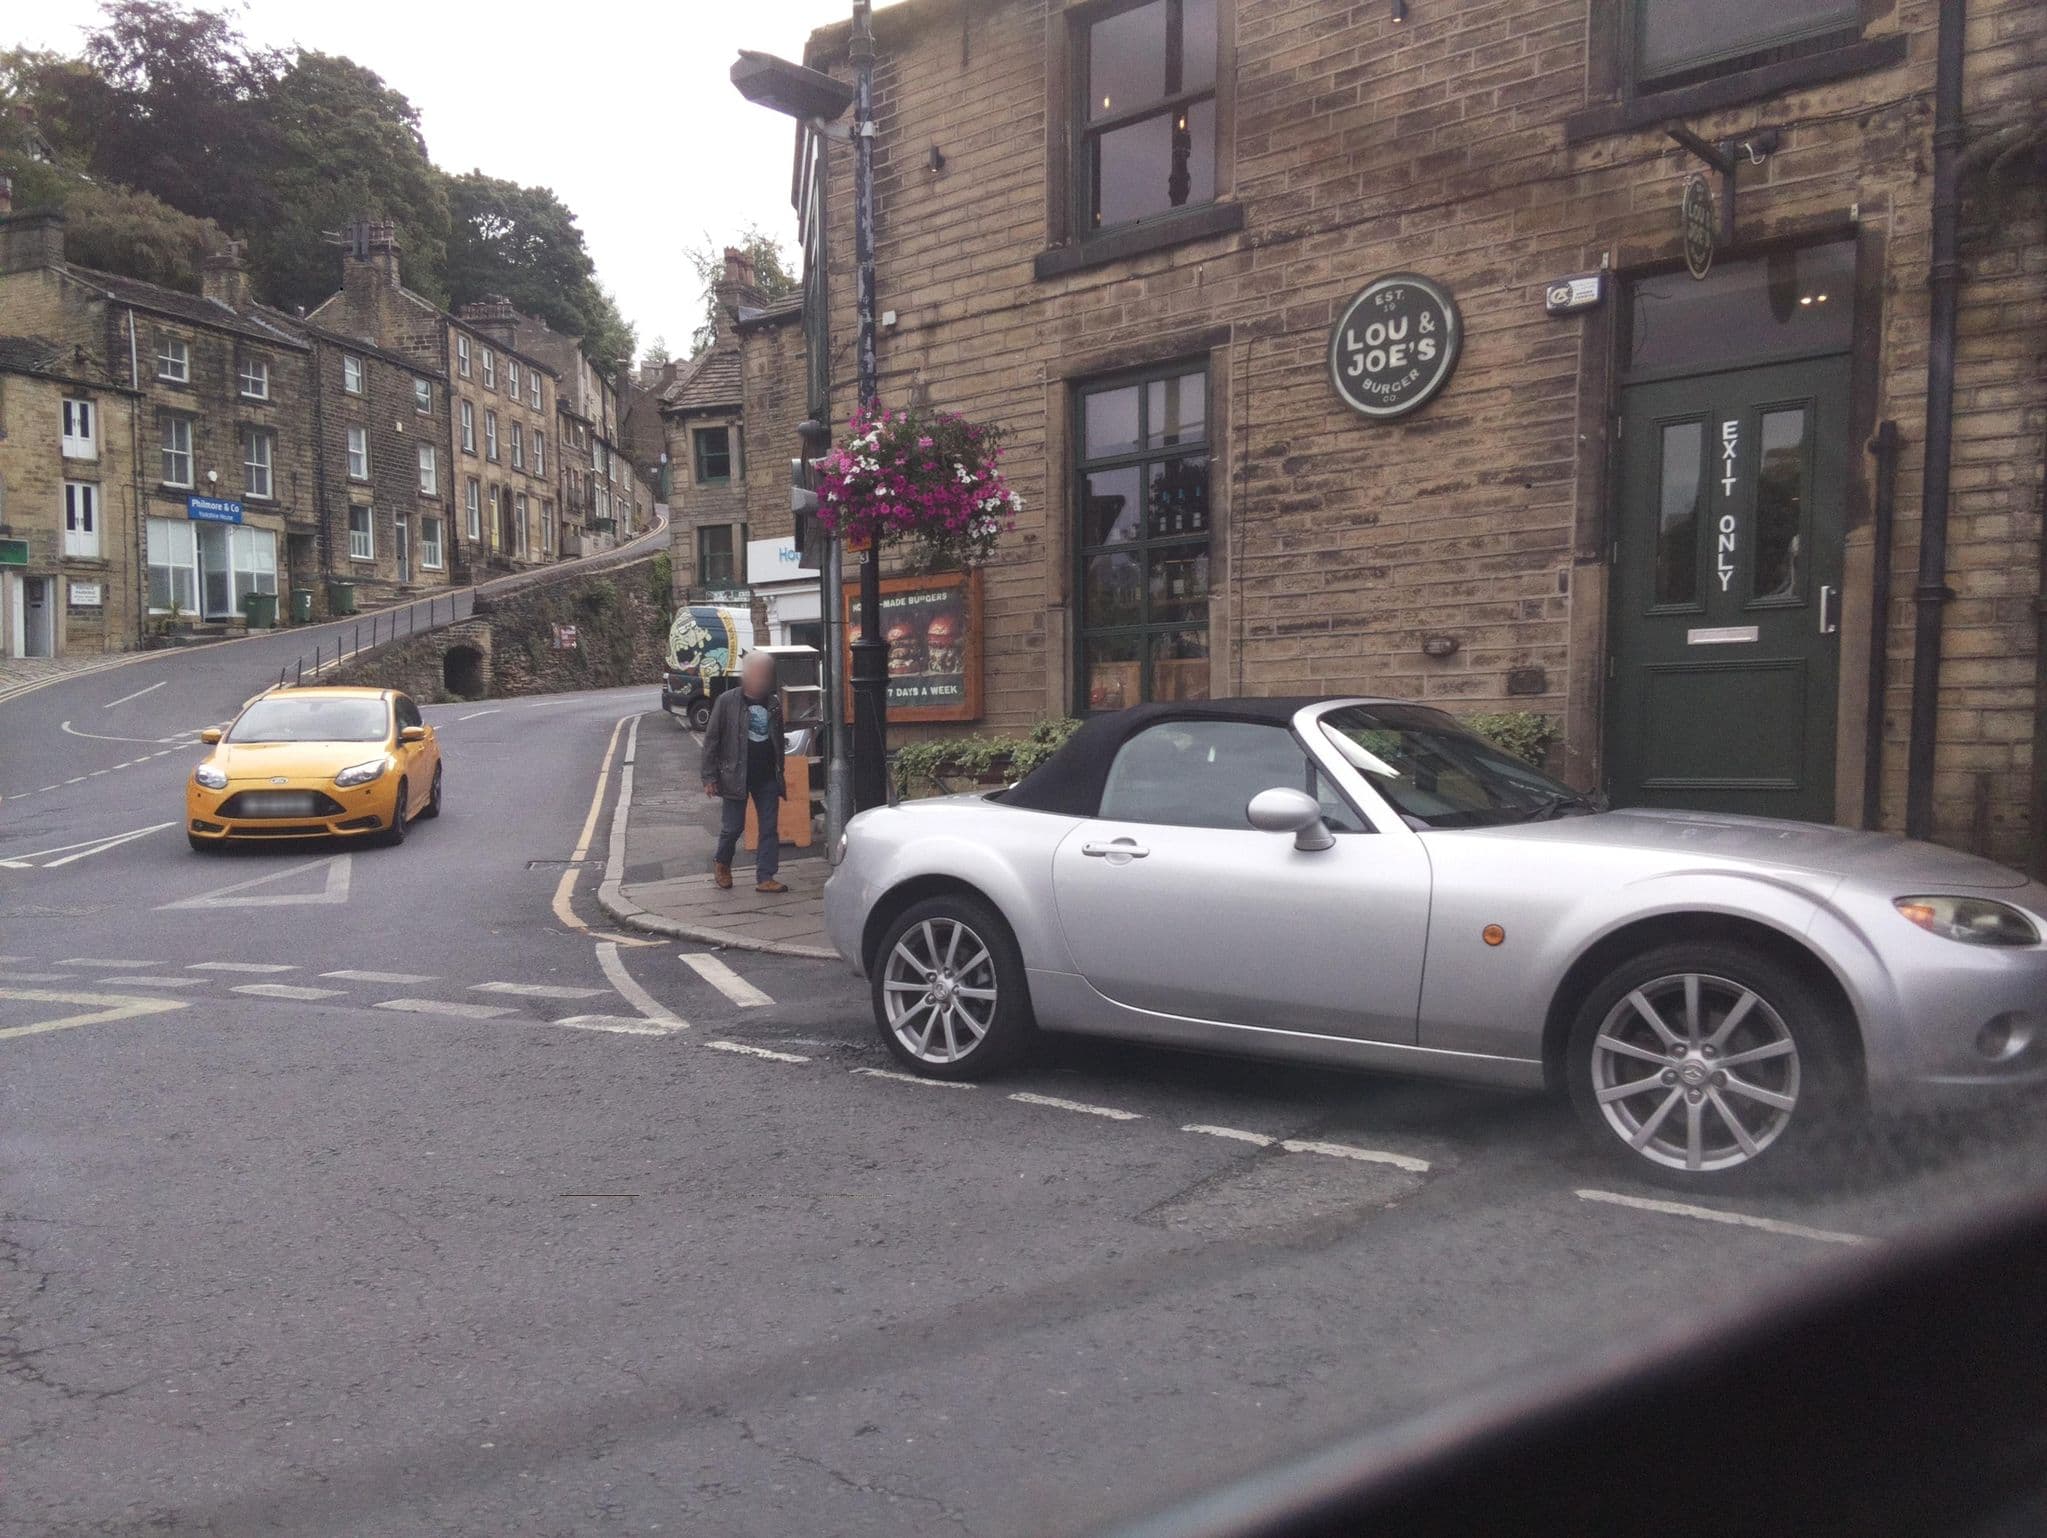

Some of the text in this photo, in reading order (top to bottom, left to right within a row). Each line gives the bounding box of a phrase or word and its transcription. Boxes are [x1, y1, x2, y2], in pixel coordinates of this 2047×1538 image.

[1375, 289, 1405, 305] EST.
[1347, 311, 1435, 351] LOU &
[1347, 338, 1436, 376] JOE'S
[1362, 368, 1420, 394] BURGER
[1721, 420, 1739, 496] EXIT
[223, 502, 230, 512] &
[230, 503, 240, 513] Co
[1717, 515, 1735, 592] ONLY
[305, 595, 312, 608] 3
[888, 685, 958, 697] 7 DAYS A WEEK
